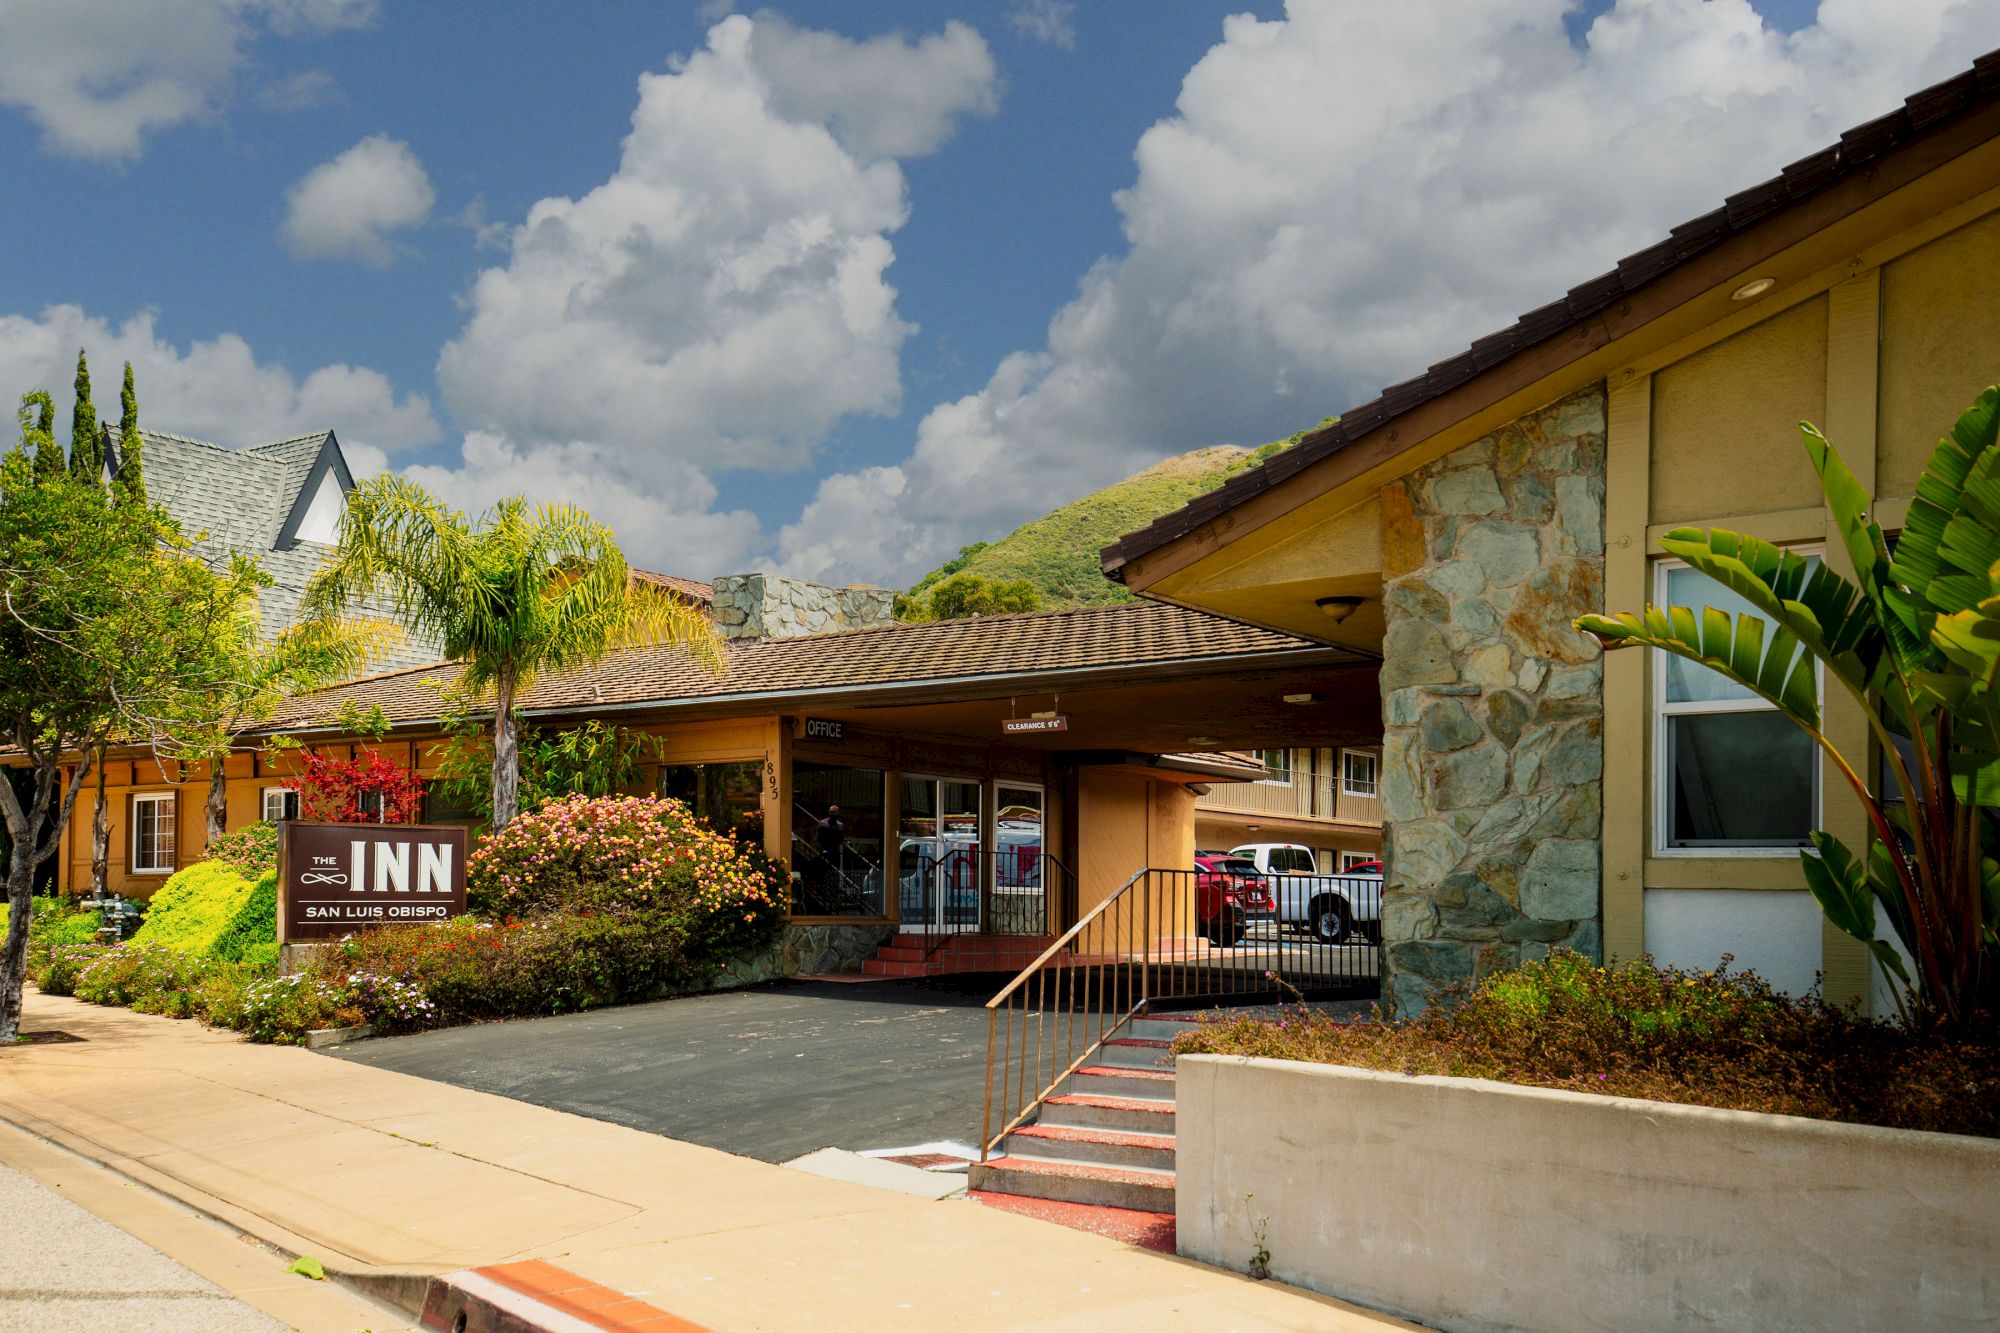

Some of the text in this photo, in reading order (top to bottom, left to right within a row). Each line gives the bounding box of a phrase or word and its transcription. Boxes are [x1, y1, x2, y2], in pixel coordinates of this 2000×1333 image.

[808, 720, 842, 738] OFFICE
[1007, 721, 1046, 730] CLEARANCE
[765, 750, 778, 800] 1895
[312, 840, 453, 892] THE INN
[306, 906, 447, 918] SAN LUIS OBISPO
